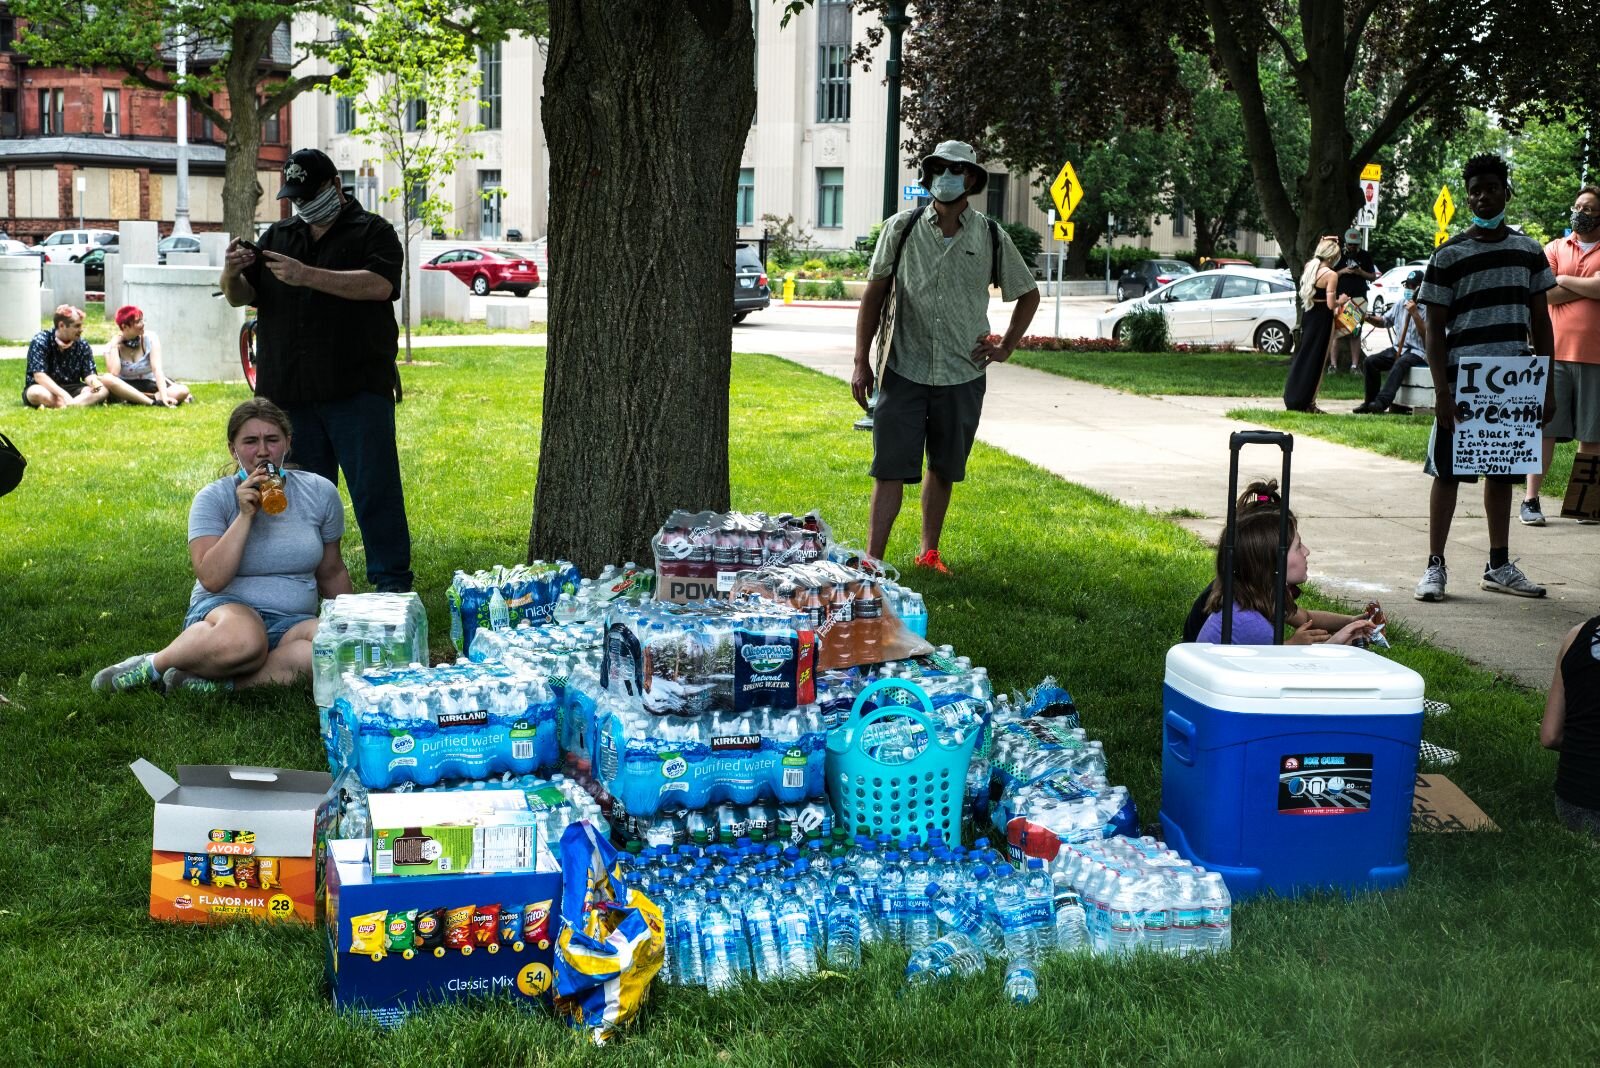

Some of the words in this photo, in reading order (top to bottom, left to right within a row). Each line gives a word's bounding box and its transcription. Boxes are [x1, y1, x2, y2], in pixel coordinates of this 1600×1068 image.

[1460, 363, 1482, 394] I
[1486, 358, 1545, 394] Can't
[1491, 440, 1526, 450] change
[1456, 456, 1474, 464] like
[1489, 456, 1520, 464] neither
[526, 602, 557, 618] niaga
[750, 674, 782, 682] Natural
[743, 682, 764, 692] SPRING
[440, 712, 486, 723] KIRKLAND
[422, 736, 468, 754] purified
[472, 733, 504, 747] water
[714, 736, 760, 746] KIRKLAND
[694, 759, 740, 778] purified
[744, 758, 776, 772] water
[208, 844, 240, 854] AVOR
[199, 896, 240, 906] FLAVOR
[244, 898, 264, 908] MIX
[272, 900, 290, 910] 28
[526, 971, 543, 983] 54
[448, 977, 488, 990] Classic
[492, 976, 514, 987] Mix
